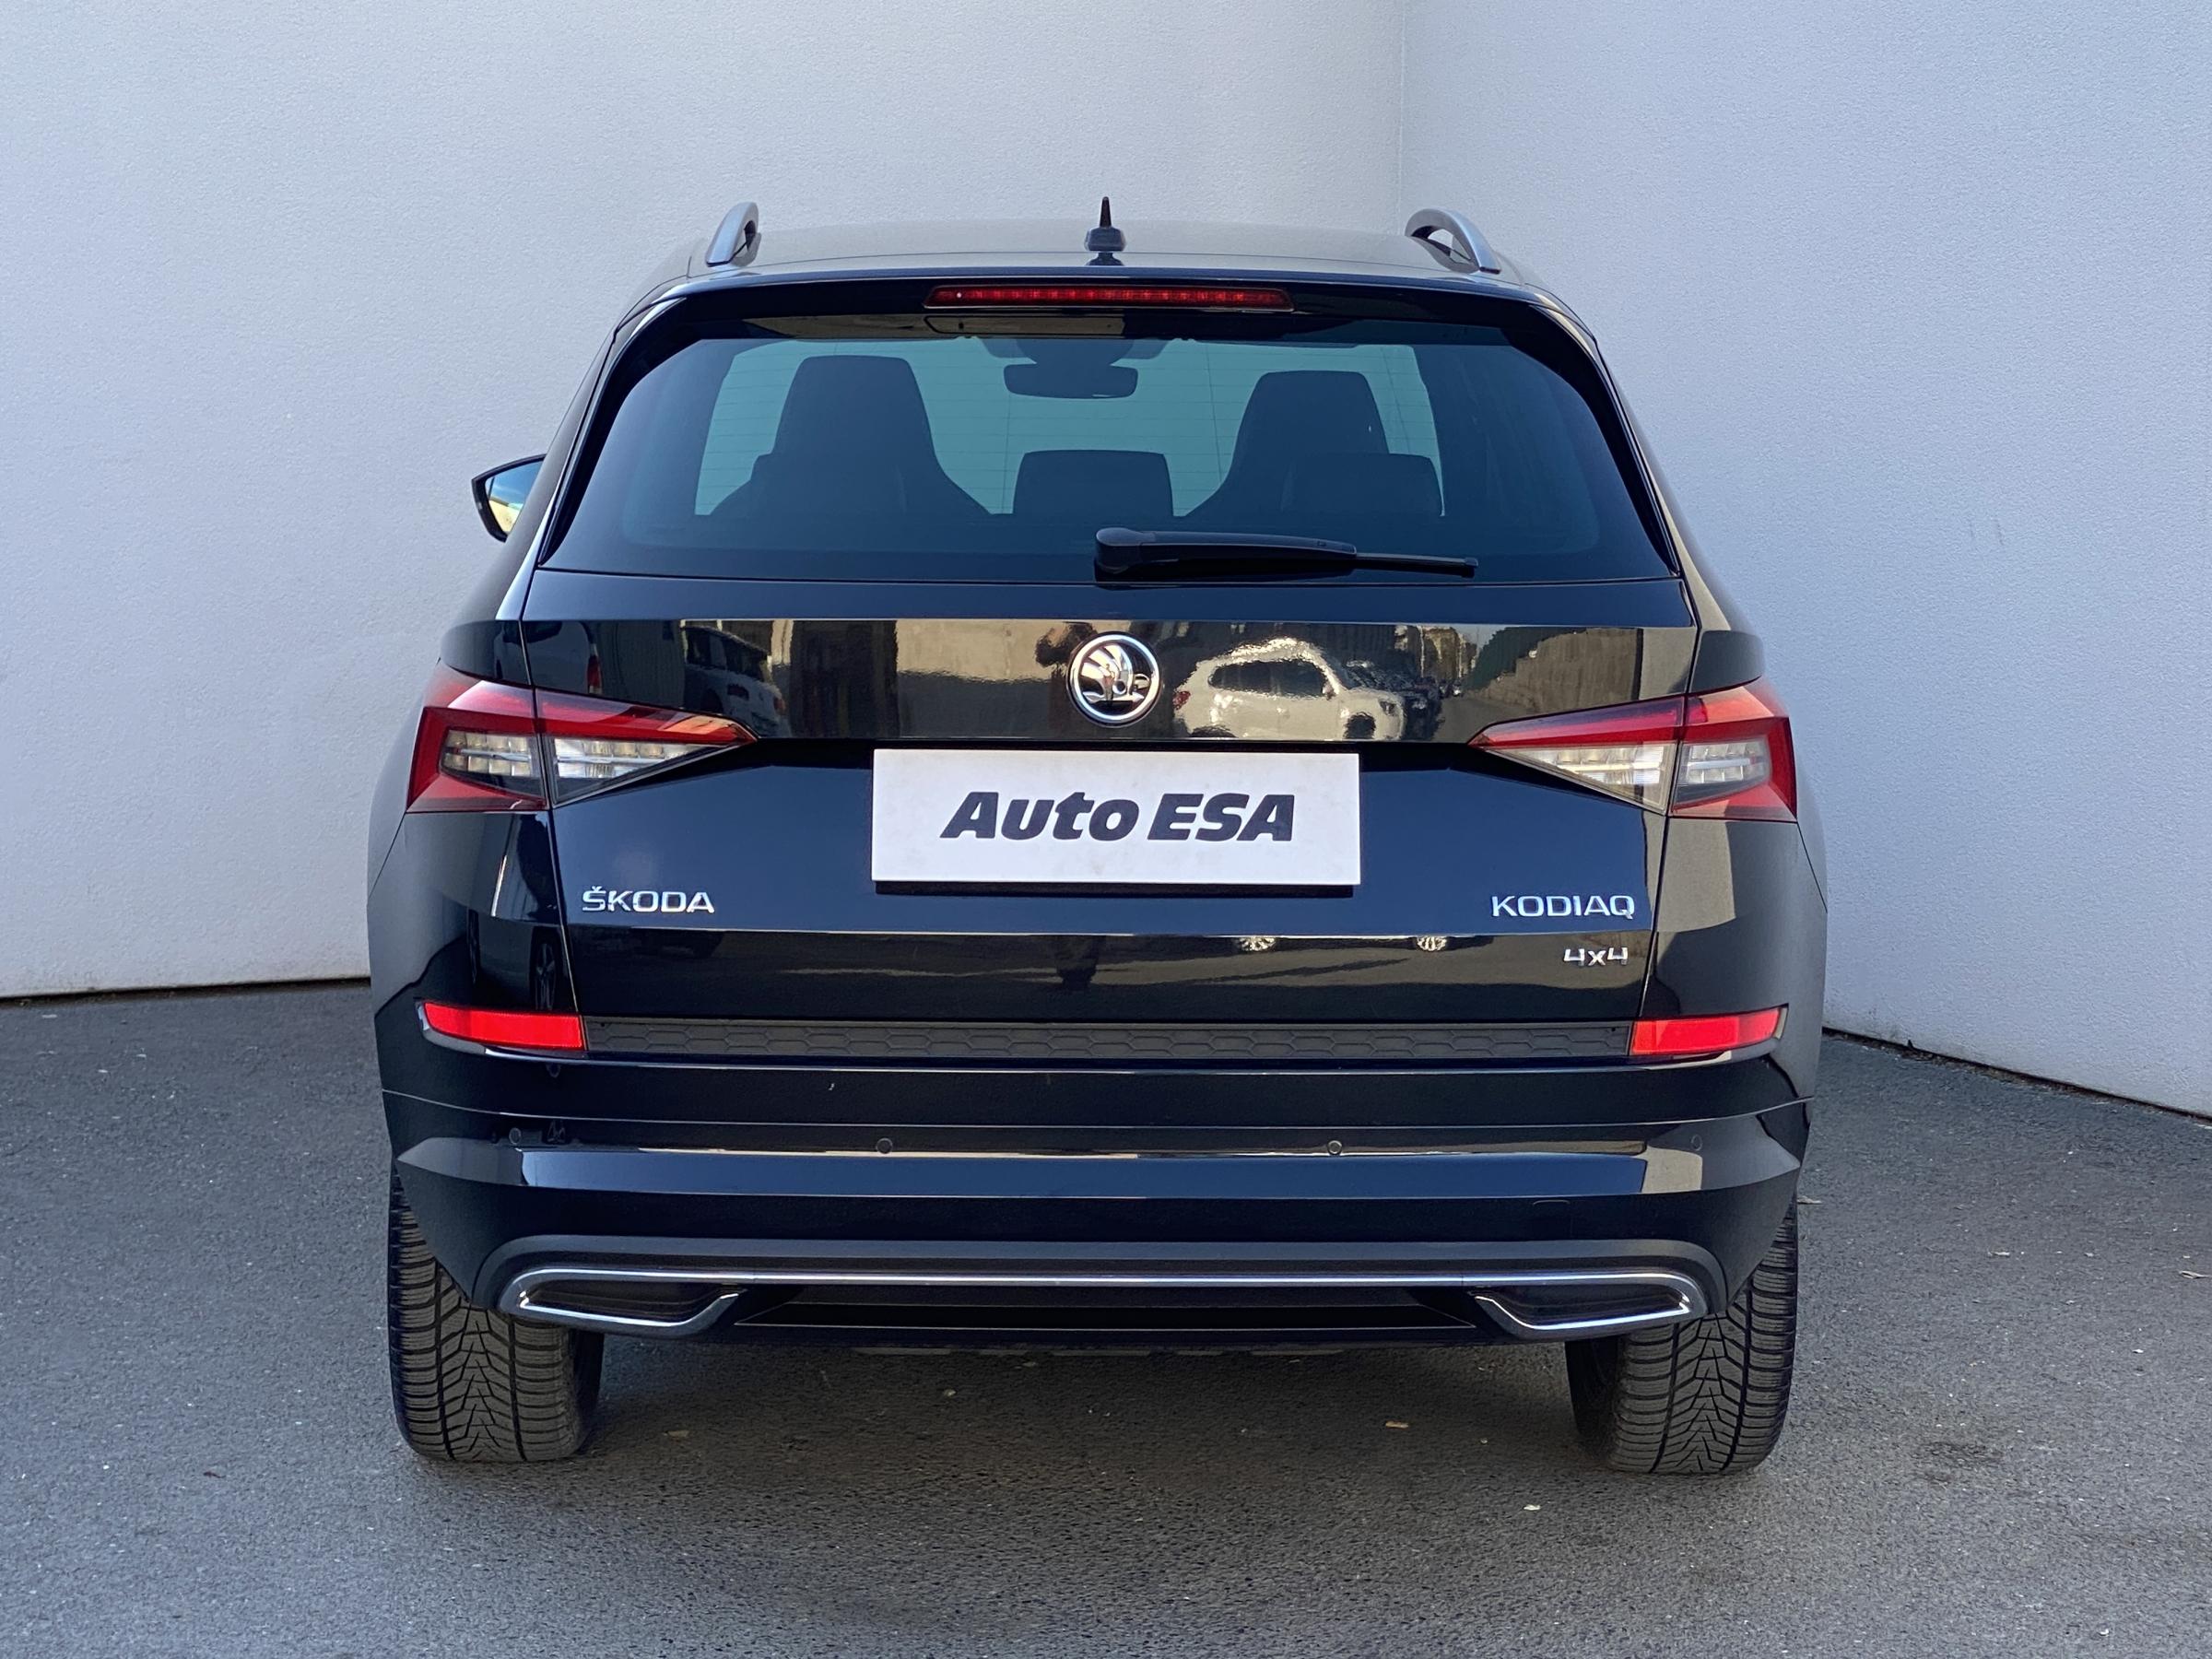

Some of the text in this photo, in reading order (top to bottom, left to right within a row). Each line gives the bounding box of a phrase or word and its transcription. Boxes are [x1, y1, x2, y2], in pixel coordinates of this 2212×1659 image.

[938, 791, 1295, 842] Auto ESA
[582, 886, 715, 913] ŠKODA
[1491, 895, 1635, 920] KODIAQ
[1563, 947, 1629, 967] 4x4
